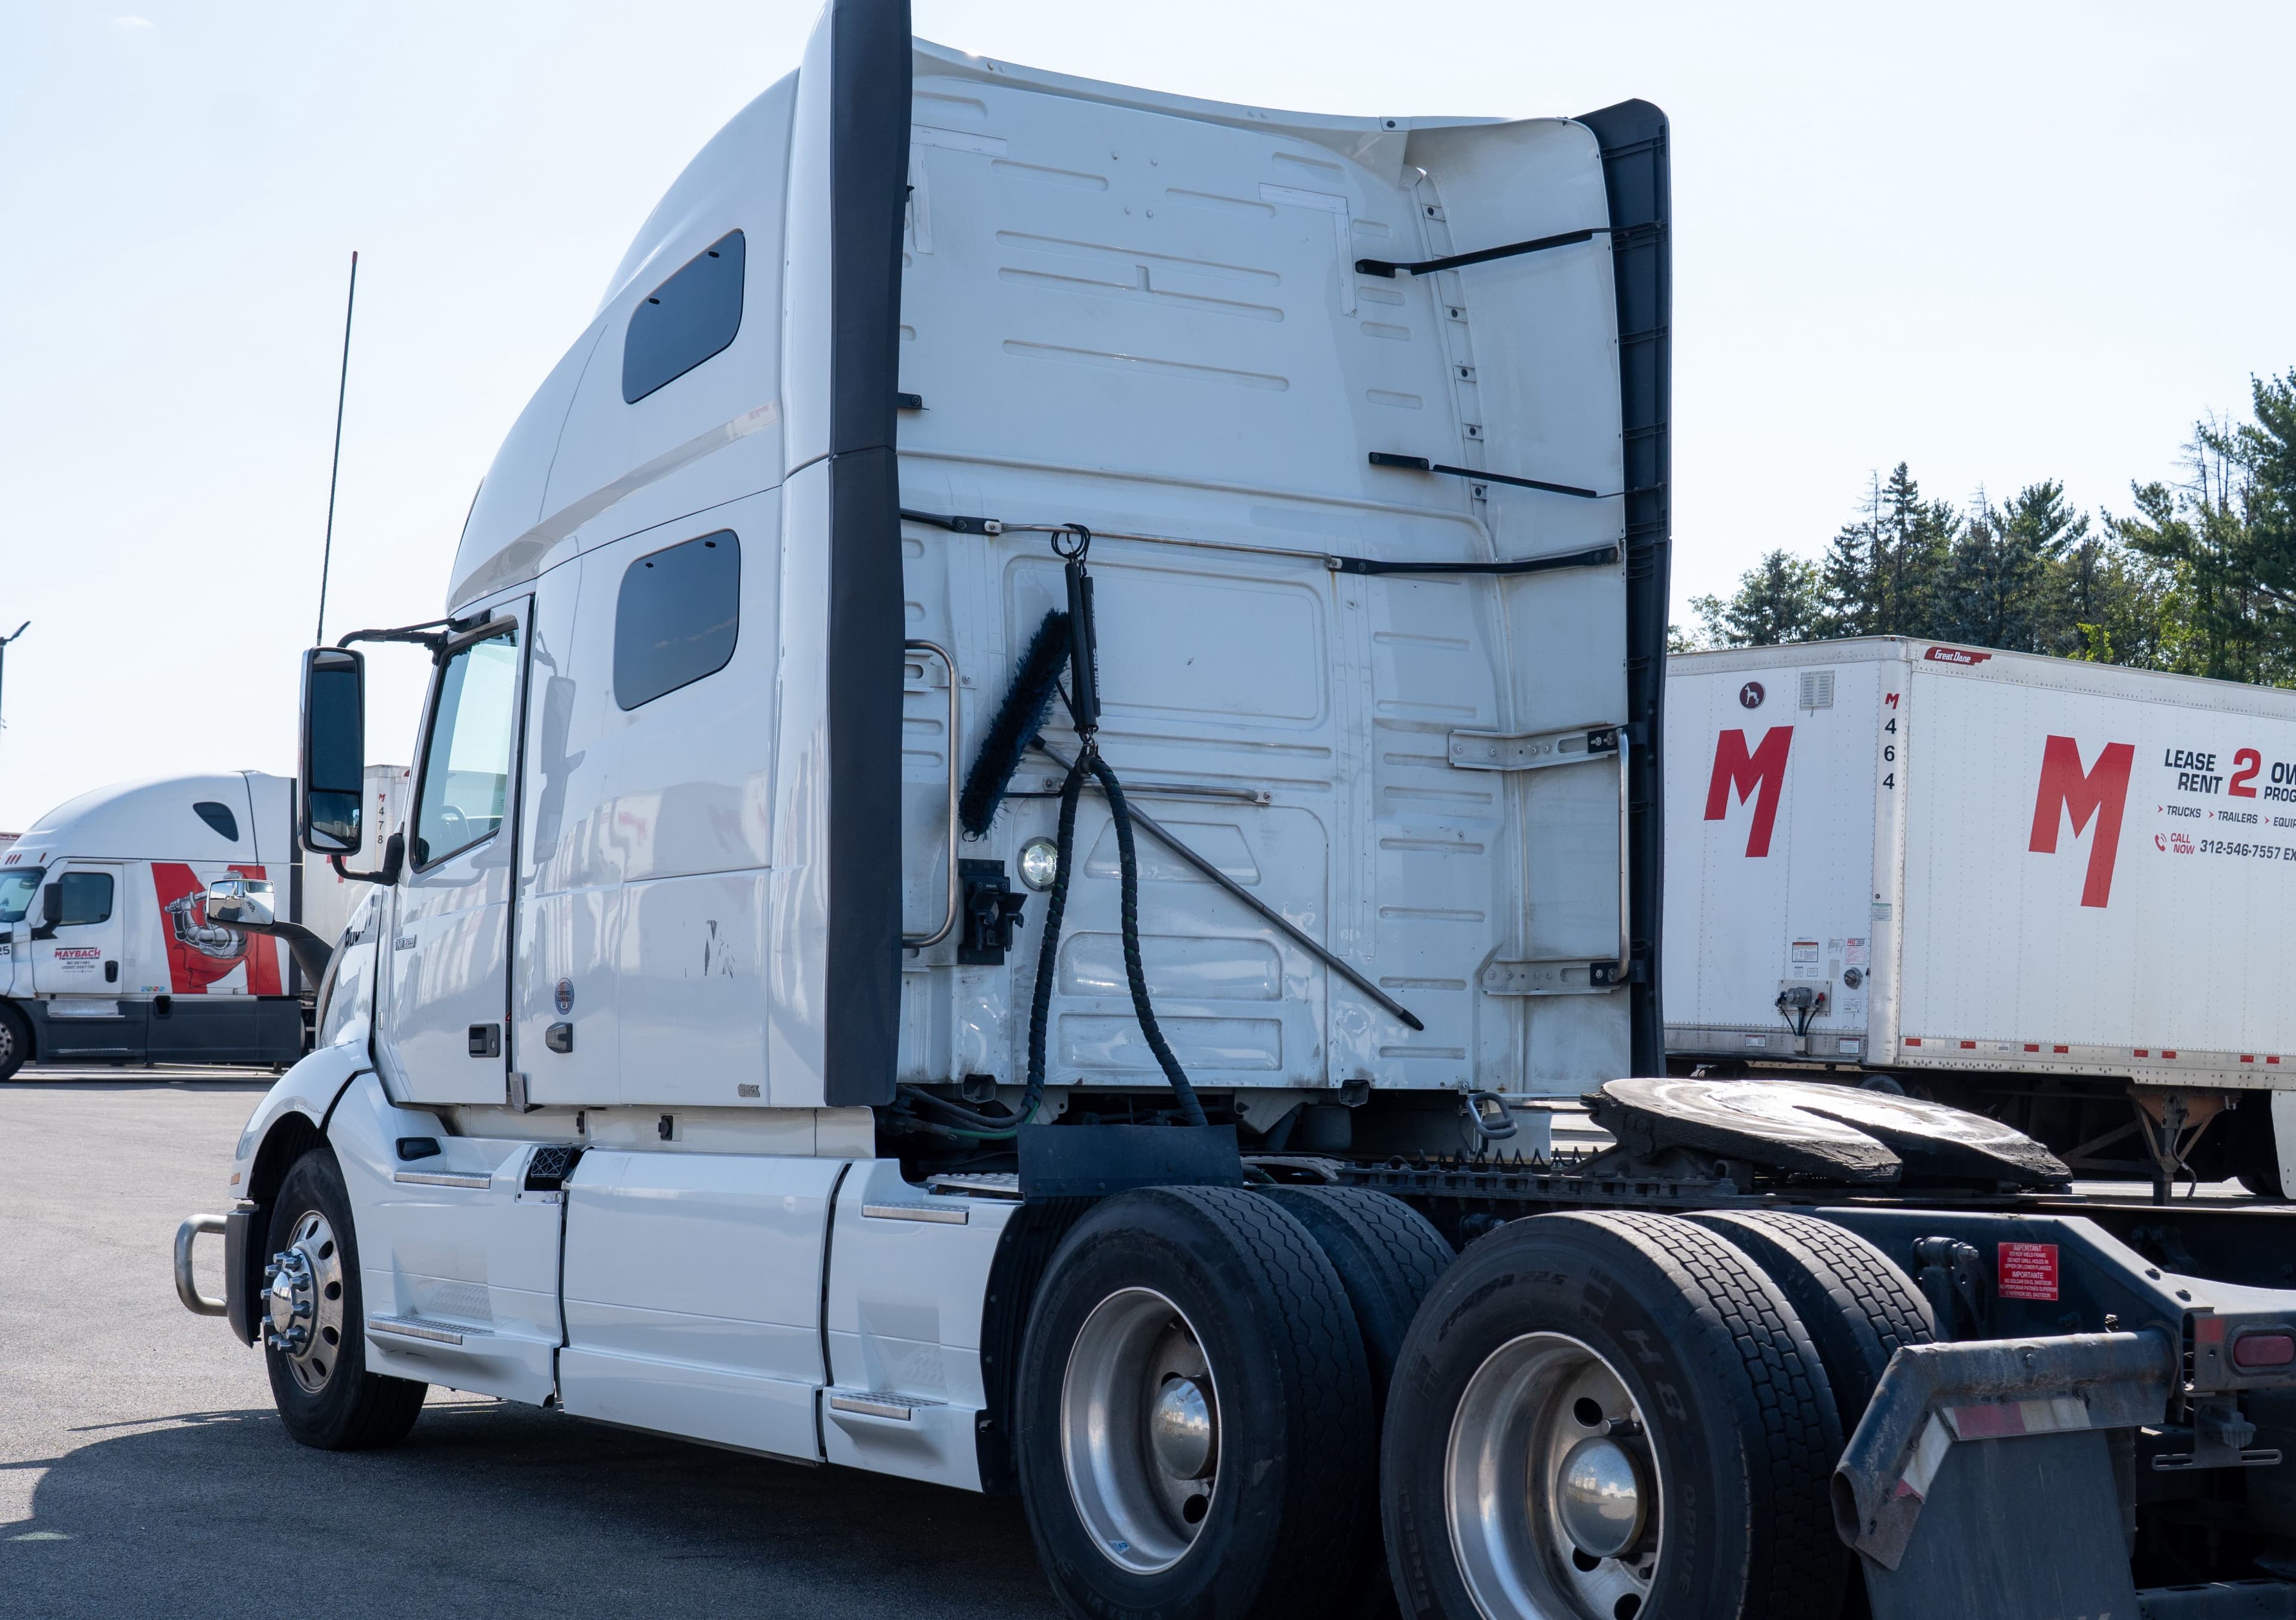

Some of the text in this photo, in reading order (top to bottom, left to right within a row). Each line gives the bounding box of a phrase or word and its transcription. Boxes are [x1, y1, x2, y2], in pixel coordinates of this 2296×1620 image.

[1935, 650, 1971, 663] Great Dane
[1885, 693, 1899, 710] M
[2164, 748, 2216, 772] LEASE
[2228, 747, 2261, 799] 2
[2178, 772, 2223, 794] RENT
[1704, 726, 1794, 857] M
[2167, 805, 2202, 818] TRUCKS
[2218, 811, 2258, 824] TRAILERS
[2028, 735, 2135, 908] M
[2170, 833, 2191, 843] CALL
[2173, 844, 2195, 854] NOW
[54, 947, 100, 959] MAYBACH
